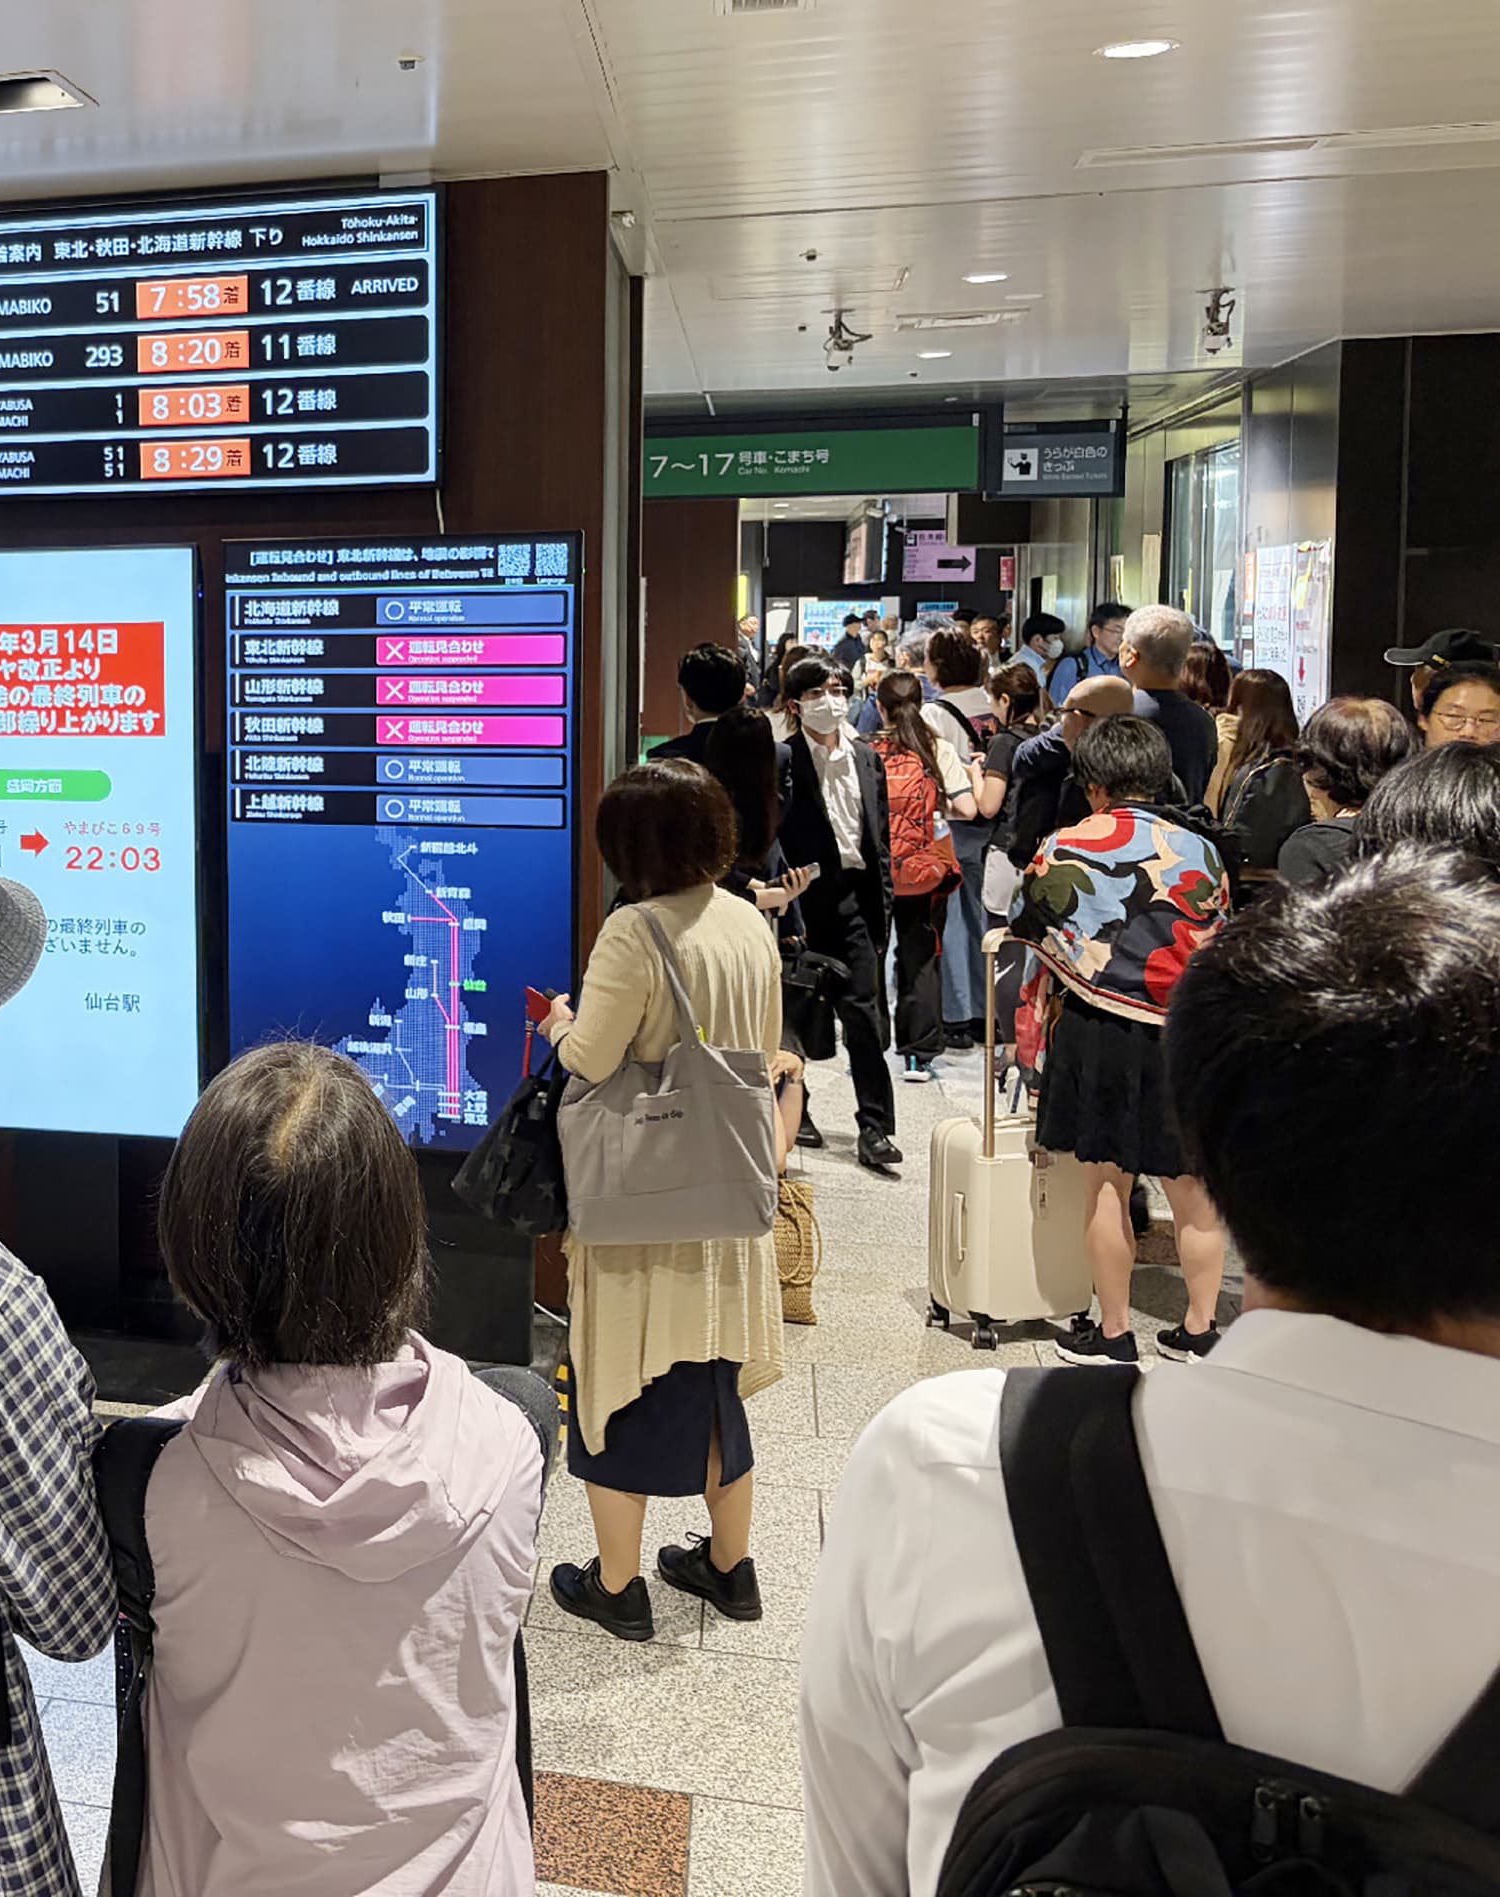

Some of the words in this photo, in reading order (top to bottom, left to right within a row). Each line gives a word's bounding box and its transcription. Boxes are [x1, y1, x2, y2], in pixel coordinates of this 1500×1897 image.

[249, 227, 284, 247] 下り
[356, 230, 419, 244] Shinkansen
[96, 291, 120, 314] 51
[350, 277, 419, 295] ARRIVED
[84, 345, 124, 368] 293
[115, 393, 123, 409] 1
[115, 409, 124, 425] 1
[738, 467, 753, 476] Car
[1043, 461, 1075, 473] きっぷ
[317, 571, 337, 582] and
[339, 570, 389, 581] outbound
[418, 569, 431, 579] of
[244, 599, 340, 617] 北海道新幹線
[244, 638, 324, 656] 東北新幹線
[244, 678, 324, 695] 山形新幹線
[244, 716, 324, 734] 秋田新幹線
[65, 846, 161, 871] 22:03
[84, 991, 141, 1014] 仙台駅
